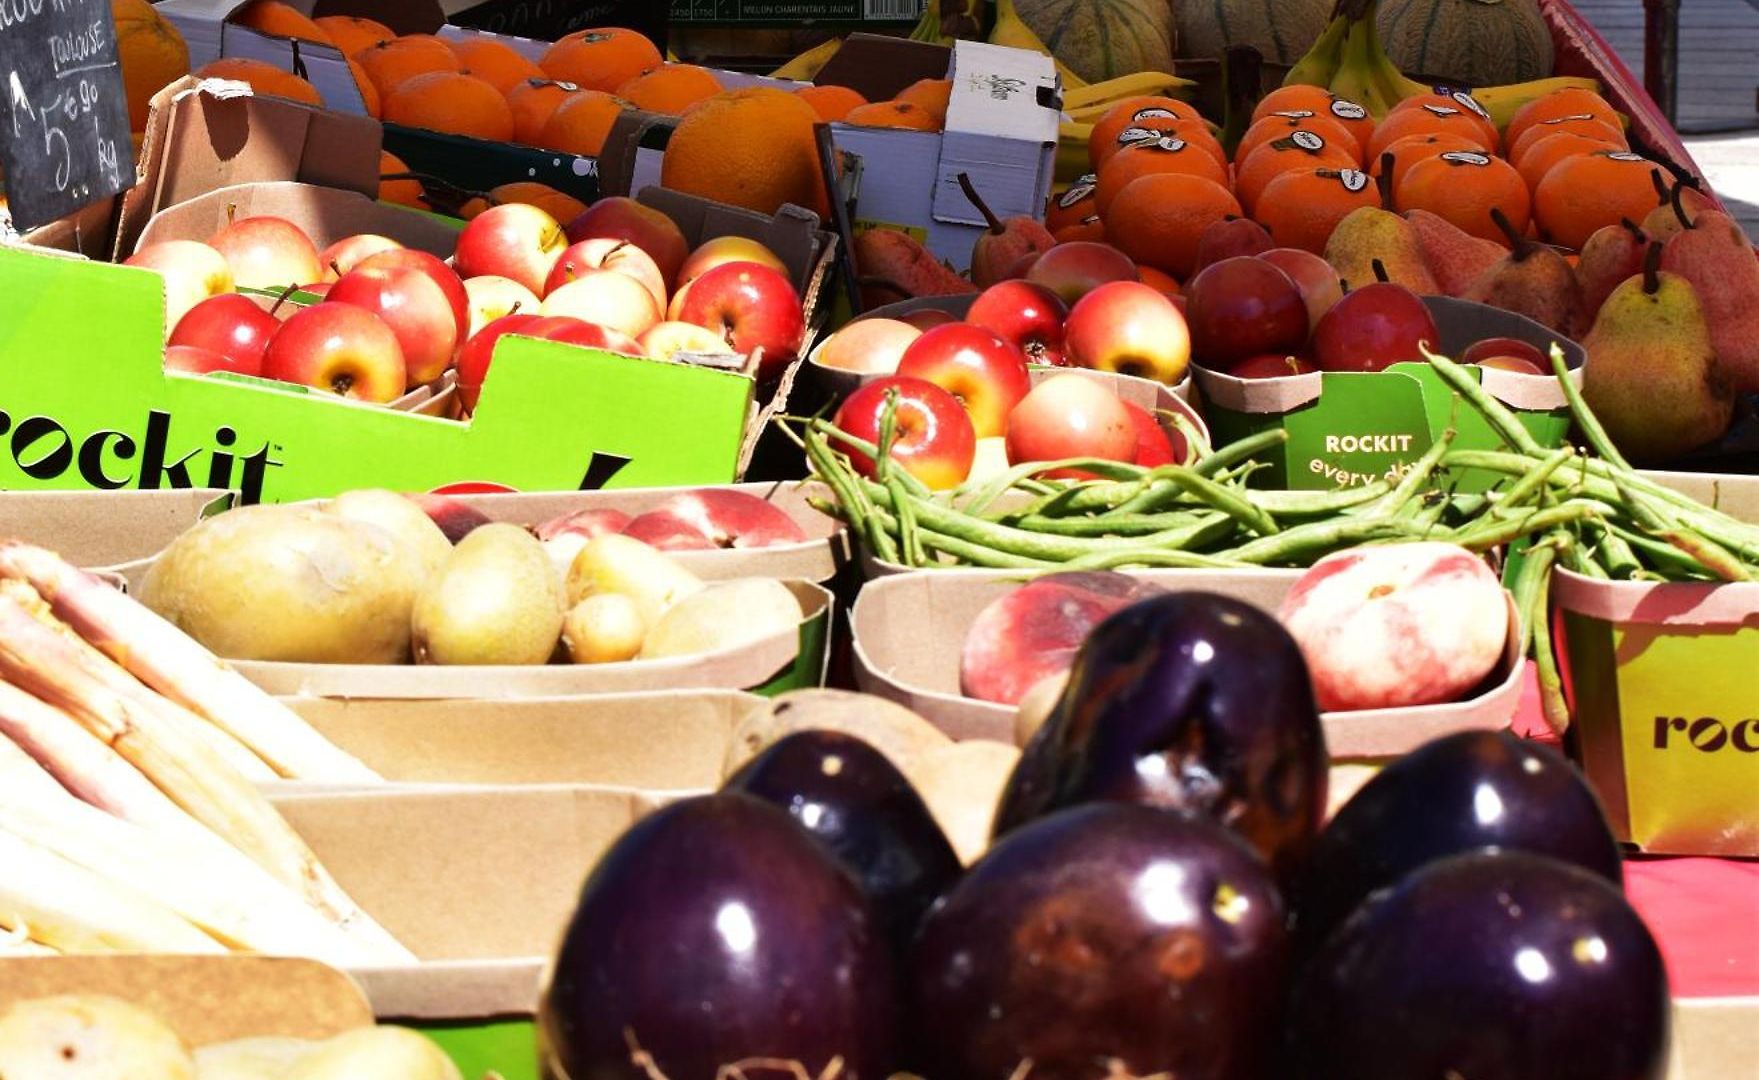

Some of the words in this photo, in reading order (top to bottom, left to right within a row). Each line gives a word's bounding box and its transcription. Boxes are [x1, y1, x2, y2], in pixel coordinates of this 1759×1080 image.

[743, 4, 773, 14] MELON
[774, 4, 826, 14] CHARENTAIS
[828, 4, 854, 14] JAUNE
[1325, 435, 1412, 453] ROCKIT
[1309, 458, 1376, 487] every
